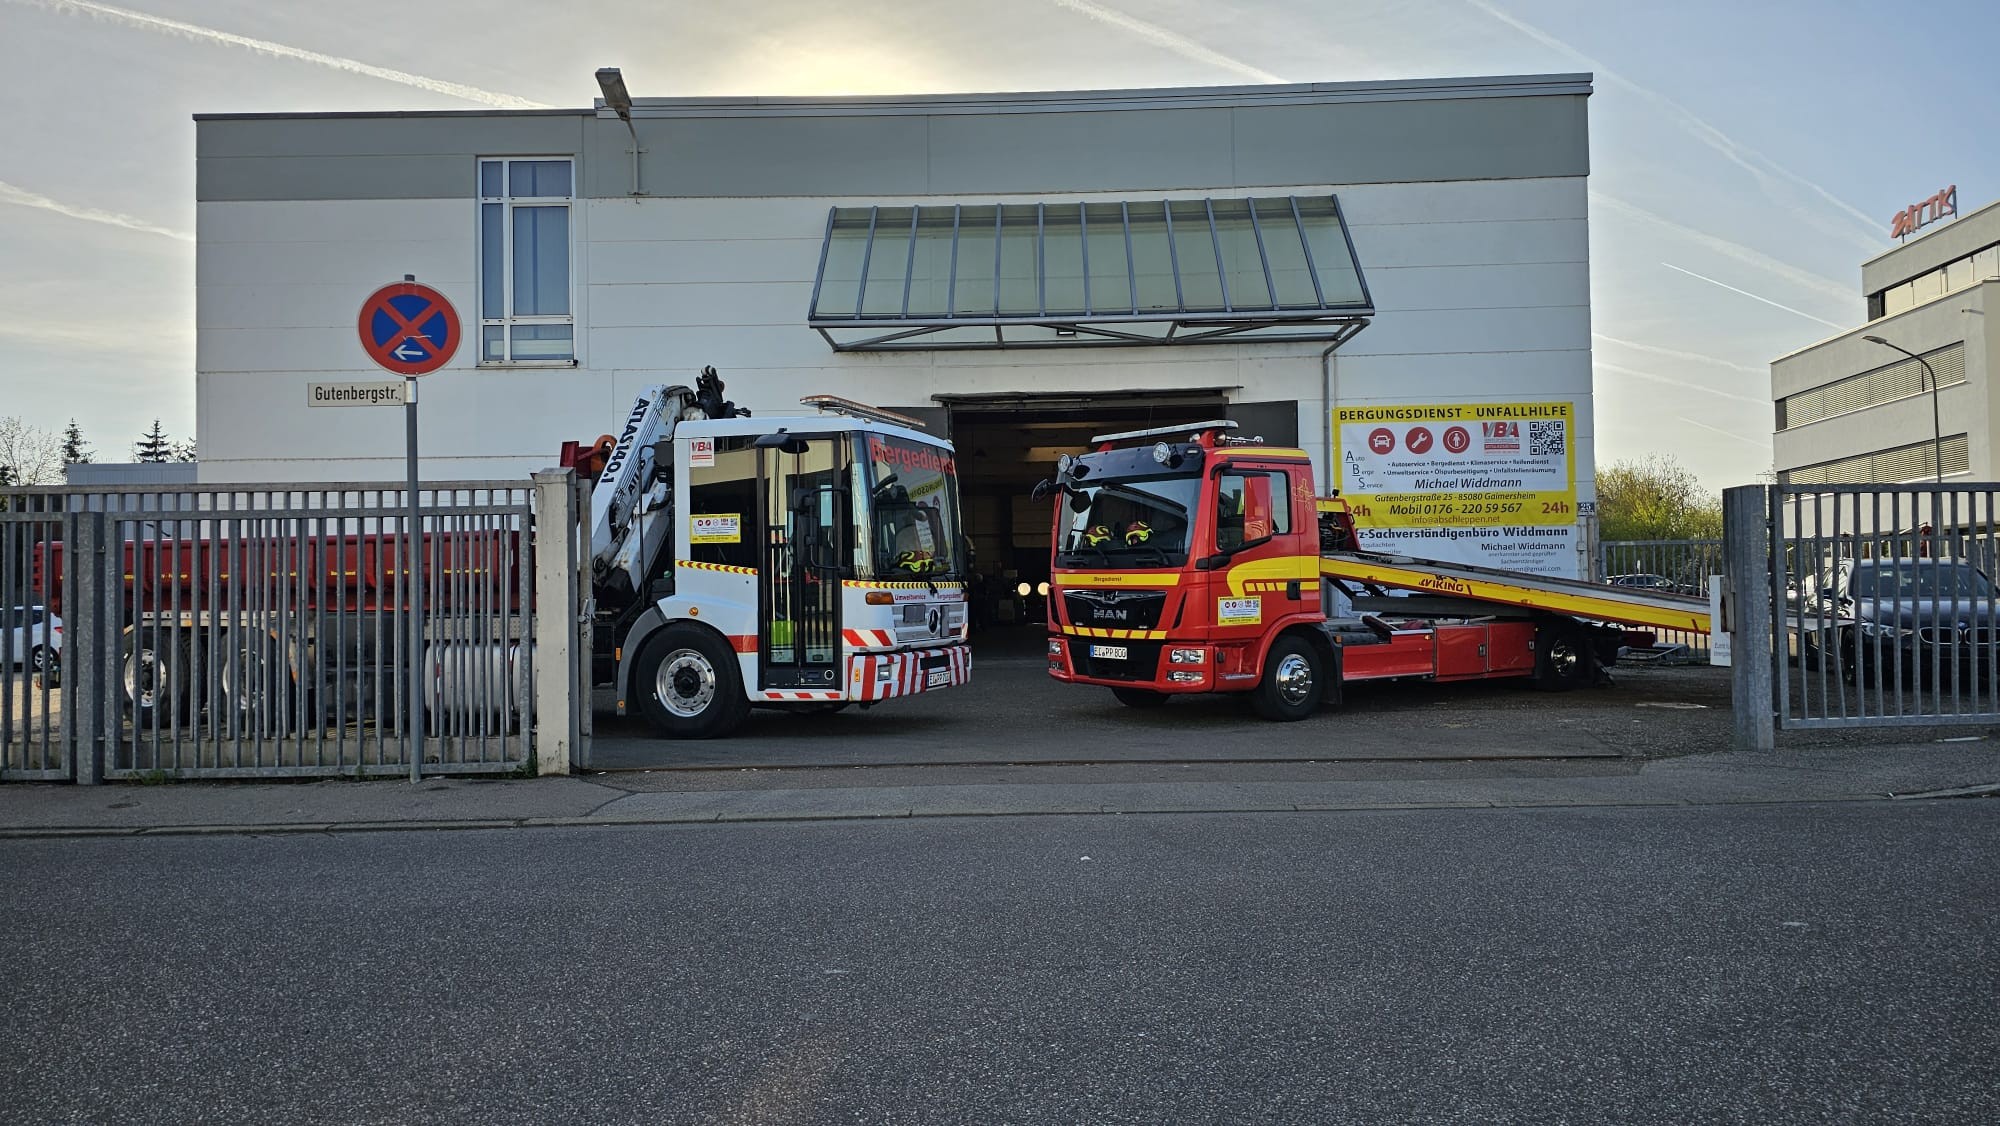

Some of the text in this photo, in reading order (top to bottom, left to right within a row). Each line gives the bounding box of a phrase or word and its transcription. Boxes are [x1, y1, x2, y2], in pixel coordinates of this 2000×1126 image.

[315, 386, 398, 403] Gutenbergstr.
[1340, 408, 1462, 420] BERGUNGSDIENST
[1476, 406, 1567, 417] UNFALLHILFE
[620, 398, 650, 443] ATLAS
[1482, 421, 1520, 437] VBA
[869, 436, 955, 475] Bergediens
[1414, 477, 1522, 489] Michael Widdmann
[1375, 493, 1441, 503] Gutenbergstraße
[1443, 493, 1453, 501] 25
[1458, 493, 1482, 501] 85080
[1484, 492, 1536, 500] Gaimersheim
[1389, 504, 1422, 515] Mobil
[1424, 504, 1453, 514] 0176
[1461, 504, 1482, 514] 220
[1485, 503, 1499, 513] 59
[1500, 503, 1523, 513] 567
[1541, 501, 1569, 514] 24h
[1356, 526, 1568, 540] fz-Sachverständigenbüro Widdmann
[1481, 542, 1566, 551] Michael Widdmann
[1423, 578, 1464, 592] VIKING
[1093, 609, 1127, 620] MAN
